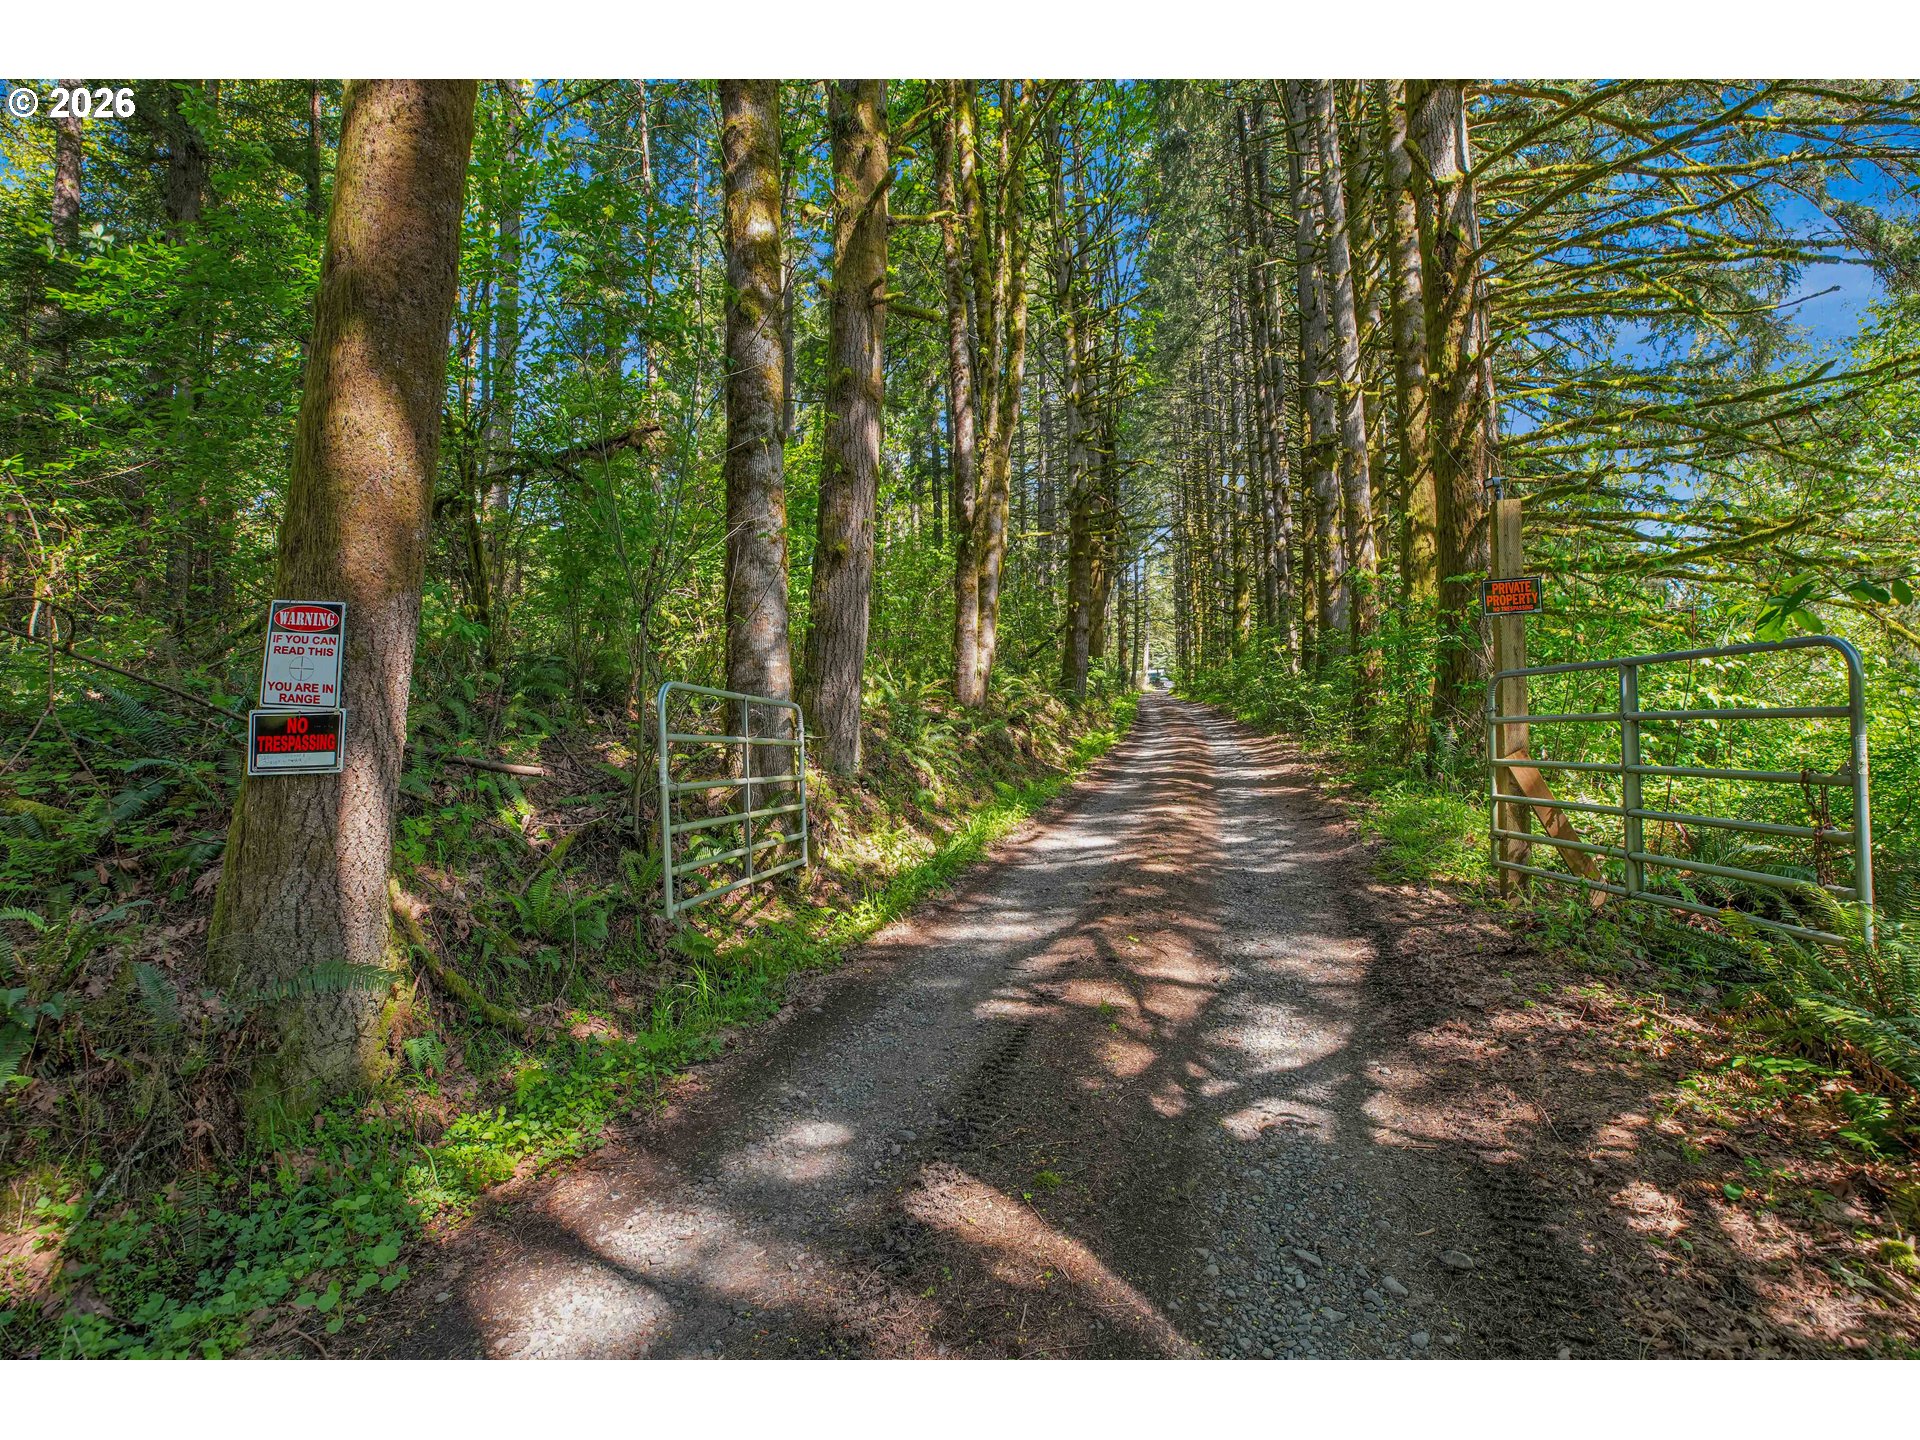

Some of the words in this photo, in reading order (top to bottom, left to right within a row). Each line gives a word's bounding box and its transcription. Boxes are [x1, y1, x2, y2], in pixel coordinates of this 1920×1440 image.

[1492, 581, 1531, 595] PRIVATE
[1486, 592, 1538, 607] PROPERTY
[279, 611, 335, 628] WARNING
[273, 634, 283, 643] IF
[285, 635, 309, 644] YOU
[312, 636, 337, 645] CAN
[273, 646, 305, 655] READ
[308, 647, 334, 656] THIS
[268, 681, 292, 691] YOU
[294, 682, 319, 692] ARE
[322, 684, 334, 693] IN
[279, 693, 320, 704] RANGE
[287, 717, 308, 734] NO
[257, 734, 335, 752] TRESPASSING
